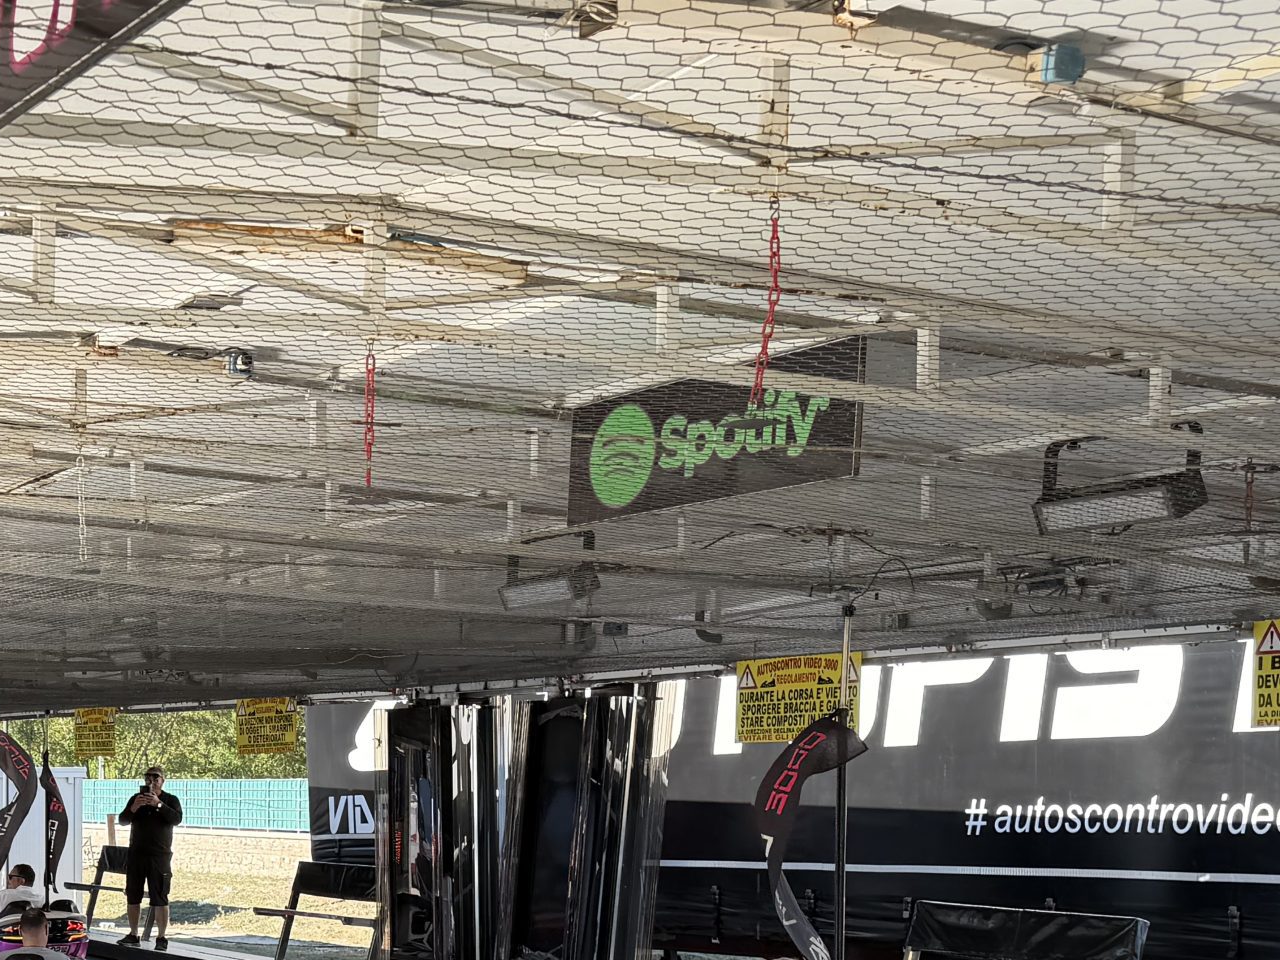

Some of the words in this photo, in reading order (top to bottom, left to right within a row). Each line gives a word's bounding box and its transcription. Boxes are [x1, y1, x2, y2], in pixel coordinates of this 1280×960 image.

[657, 389, 830, 478] spotify
[757, 657, 802, 677] AUTOSCONTRO
[803, 657, 822, 670] VIDEO
[823, 657, 839, 672] 3000
[776, 672, 817, 685] REGOLAMENTO
[1257, 674, 1280, 689] DEV
[739, 691, 775, 704] DURANTE
[776, 689, 786, 702] LA
[788, 687, 814, 701] CORSA
[816, 687, 824, 700] E'
[825, 685, 858, 699] VIETO
[1258, 693, 1273, 708] DA
[742, 703, 782, 716] SPORGERE
[783, 700, 817, 714] BRACCIA
[819, 700, 824, 712] E
[826, 698, 854, 712] GAE
[740, 716, 765, 729] STARE
[766, 714, 806, 728] COMPOSTI
